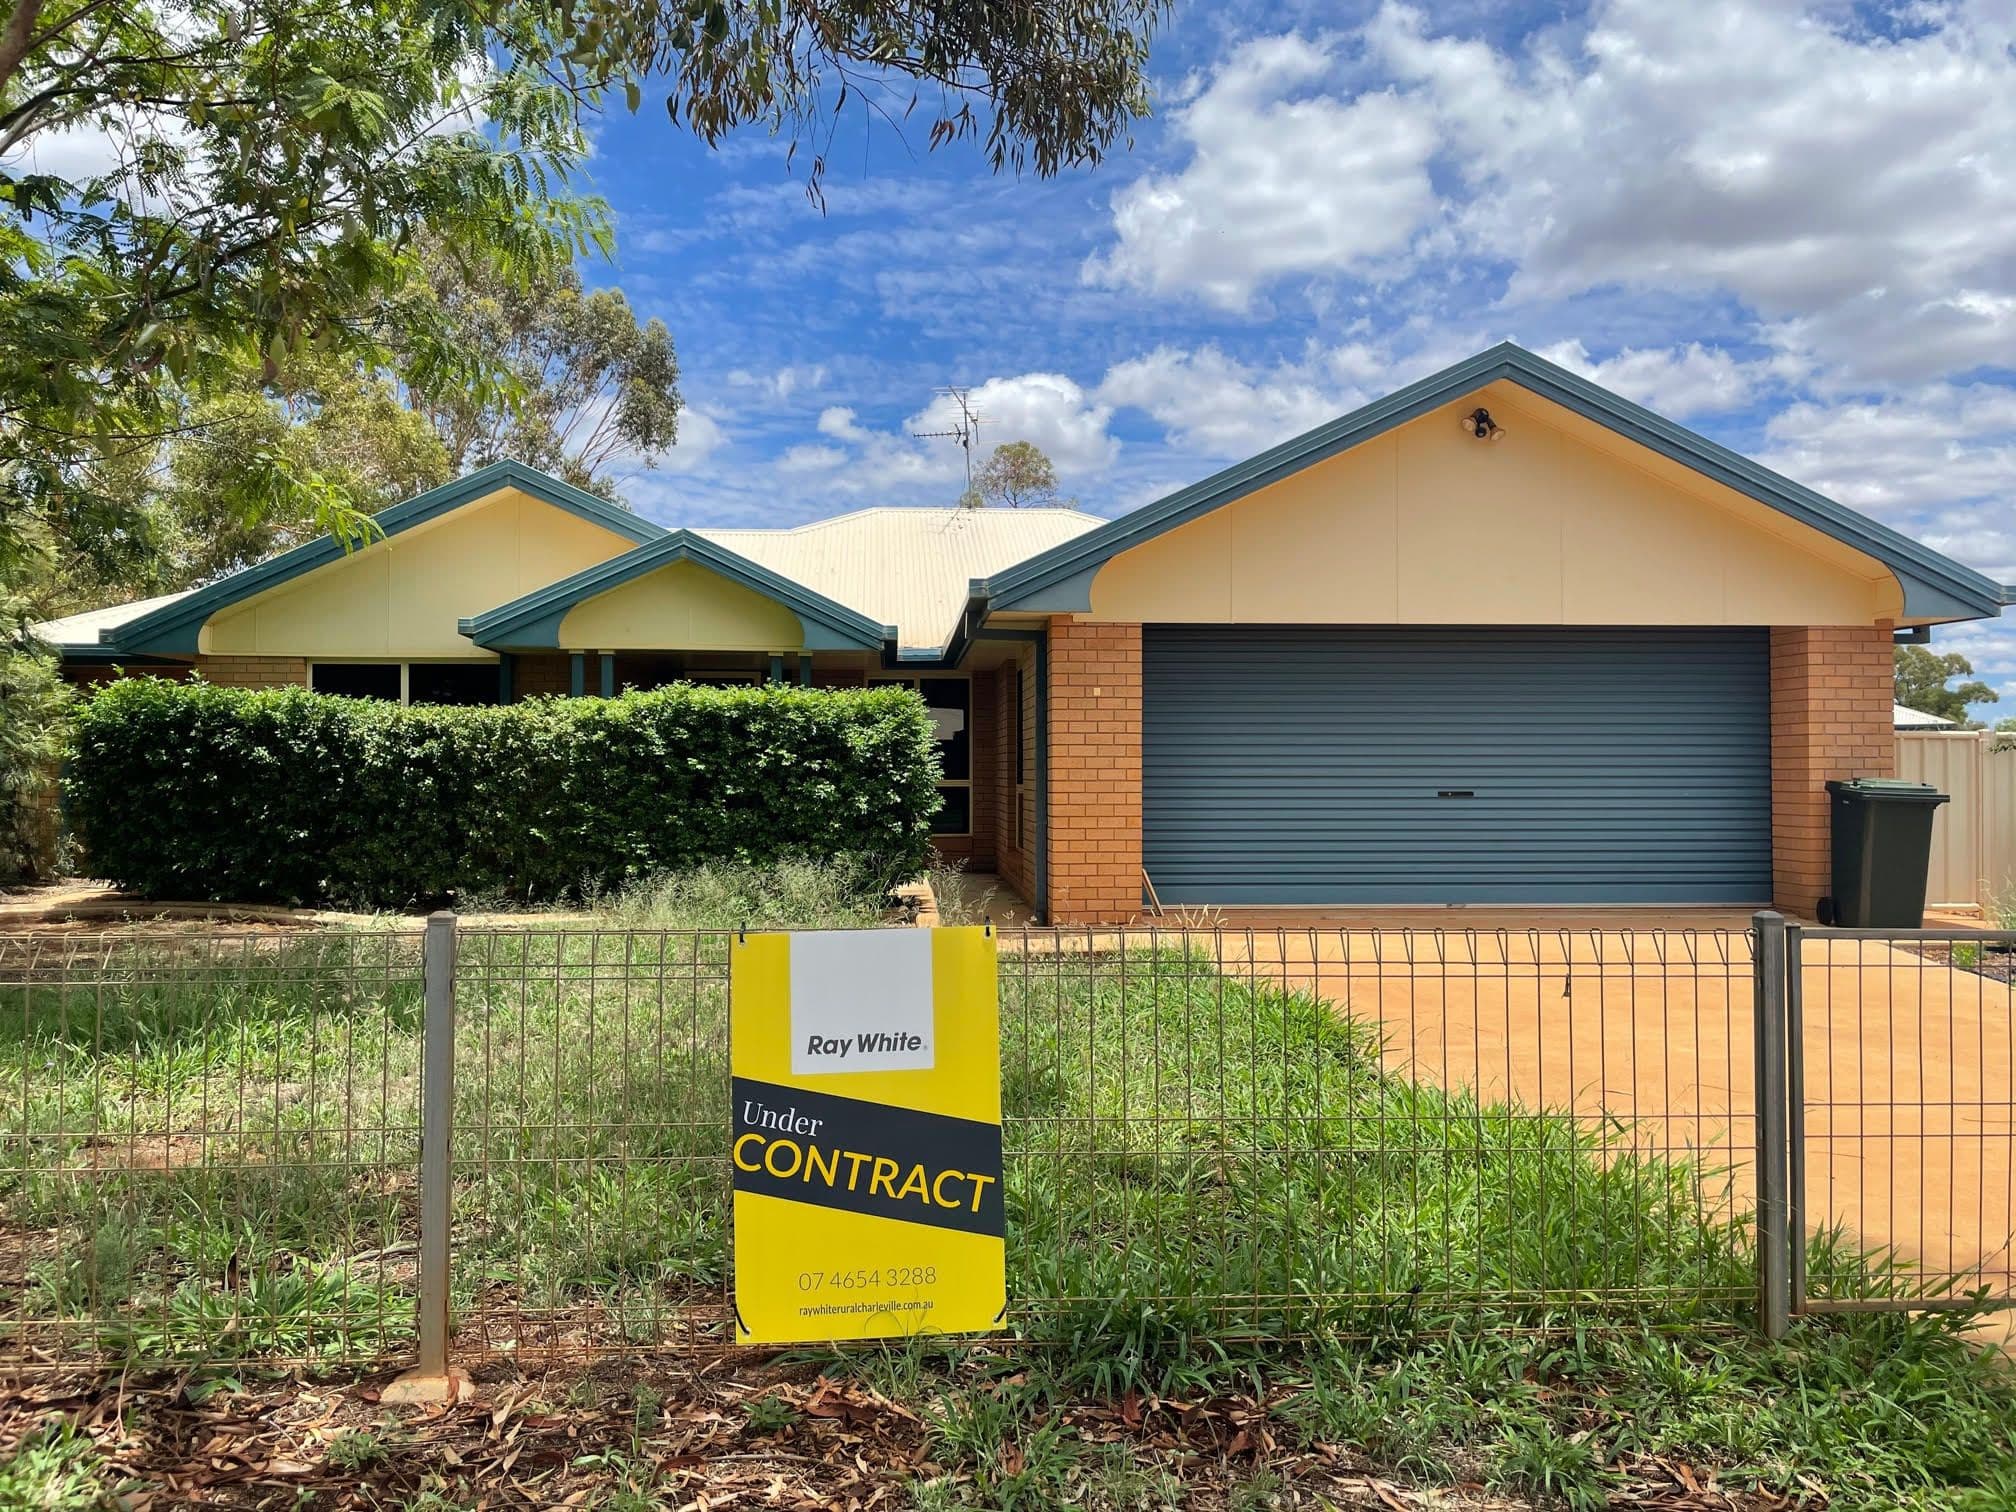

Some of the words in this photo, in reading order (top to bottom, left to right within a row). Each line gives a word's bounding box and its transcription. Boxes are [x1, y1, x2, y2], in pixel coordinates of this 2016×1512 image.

[807, 1035, 852, 1058] Ray
[857, 1031, 922, 1053] White
[743, 1100, 824, 1137] Under
[733, 1133, 995, 1213] CONTRACT
[799, 1272, 824, 1291] 07
[830, 1270, 880, 1289] 4654
[886, 1266, 937, 1287] 3288
[799, 1299, 934, 1317] raywhiteruralcharleville.com.au
